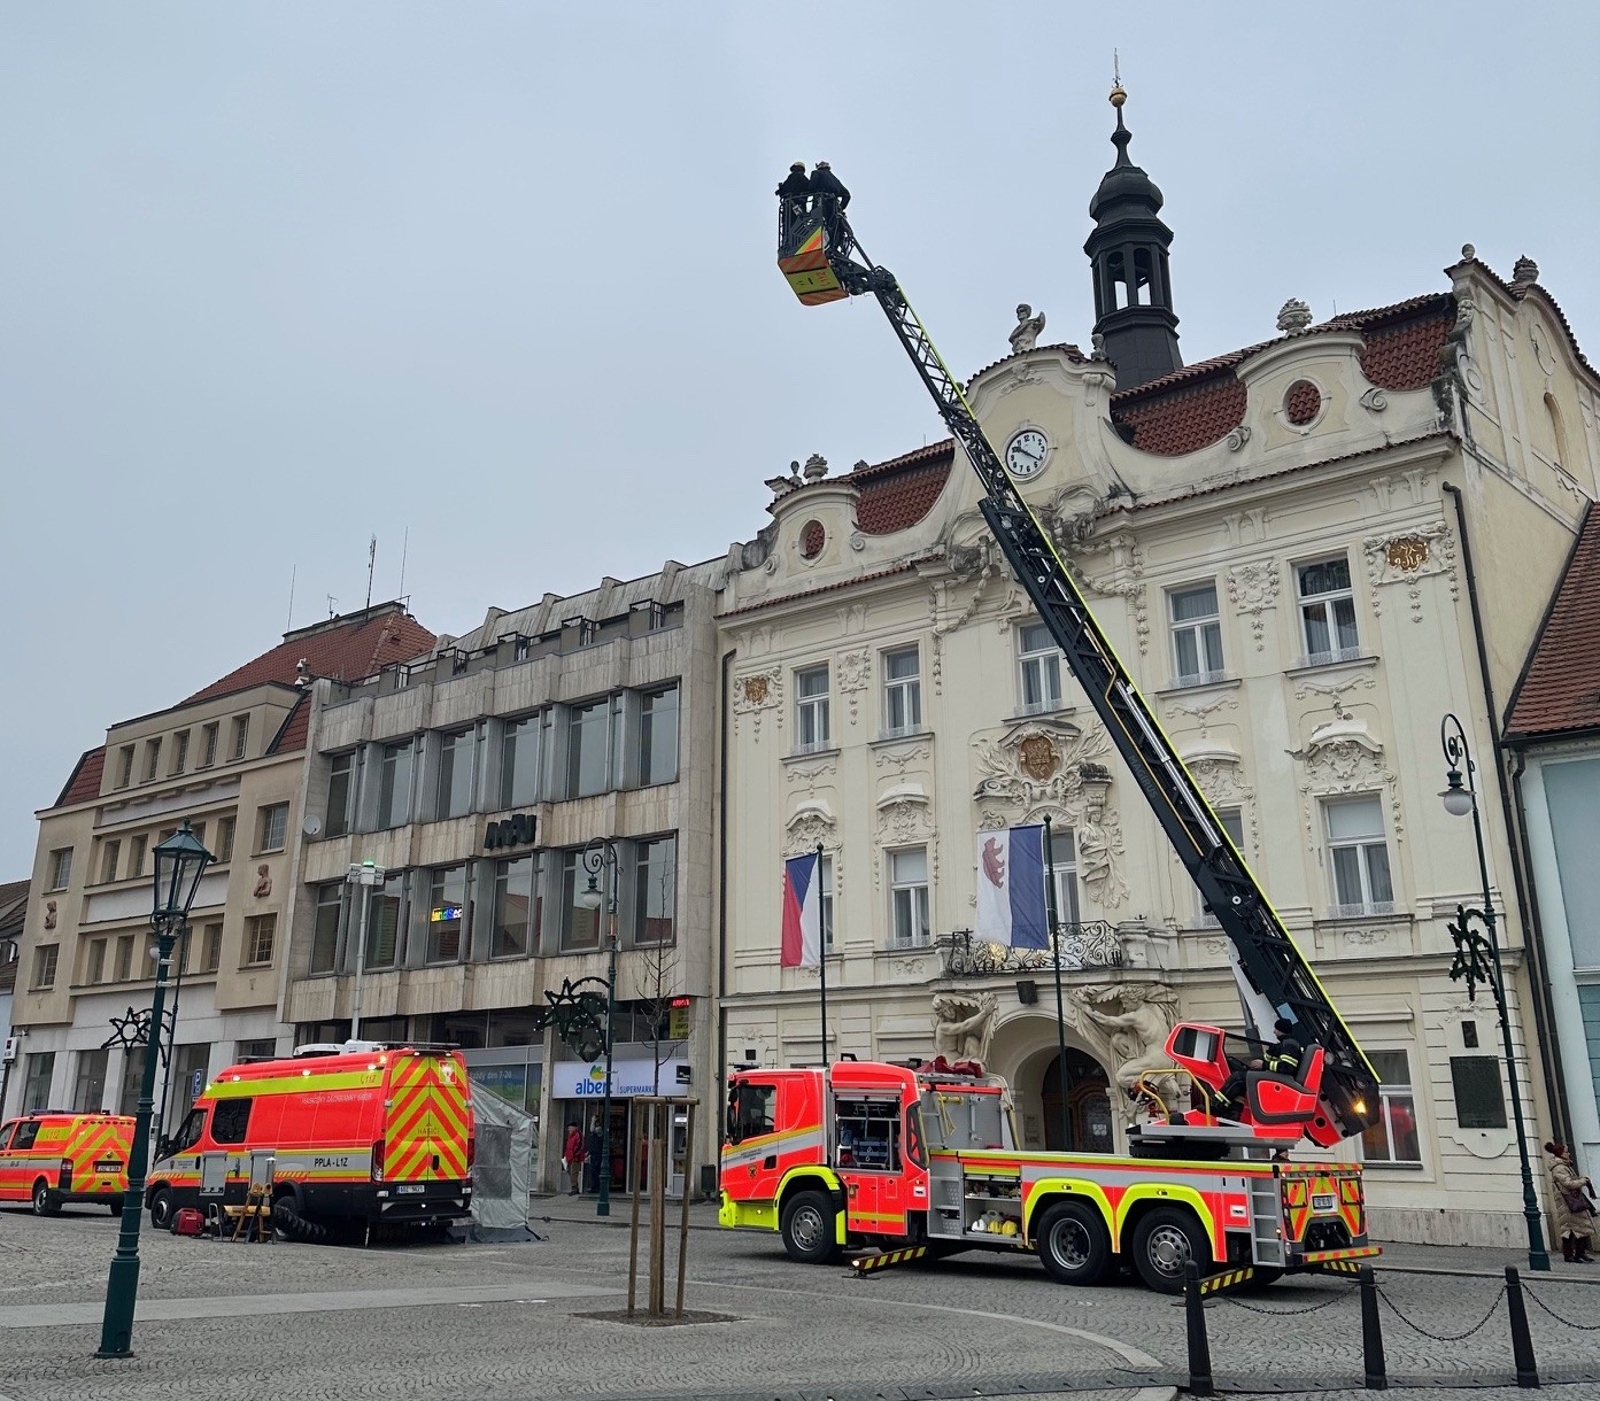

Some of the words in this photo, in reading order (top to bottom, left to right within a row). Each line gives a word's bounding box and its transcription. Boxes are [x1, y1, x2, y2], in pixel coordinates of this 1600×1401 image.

[1128, 754, 1159, 799] MAGIRUS
[620, 1085, 656, 1094] SUPERMARKE
[314, 1157, 331, 1168] PPLA
[336, 1157, 349, 1167] L1Z
